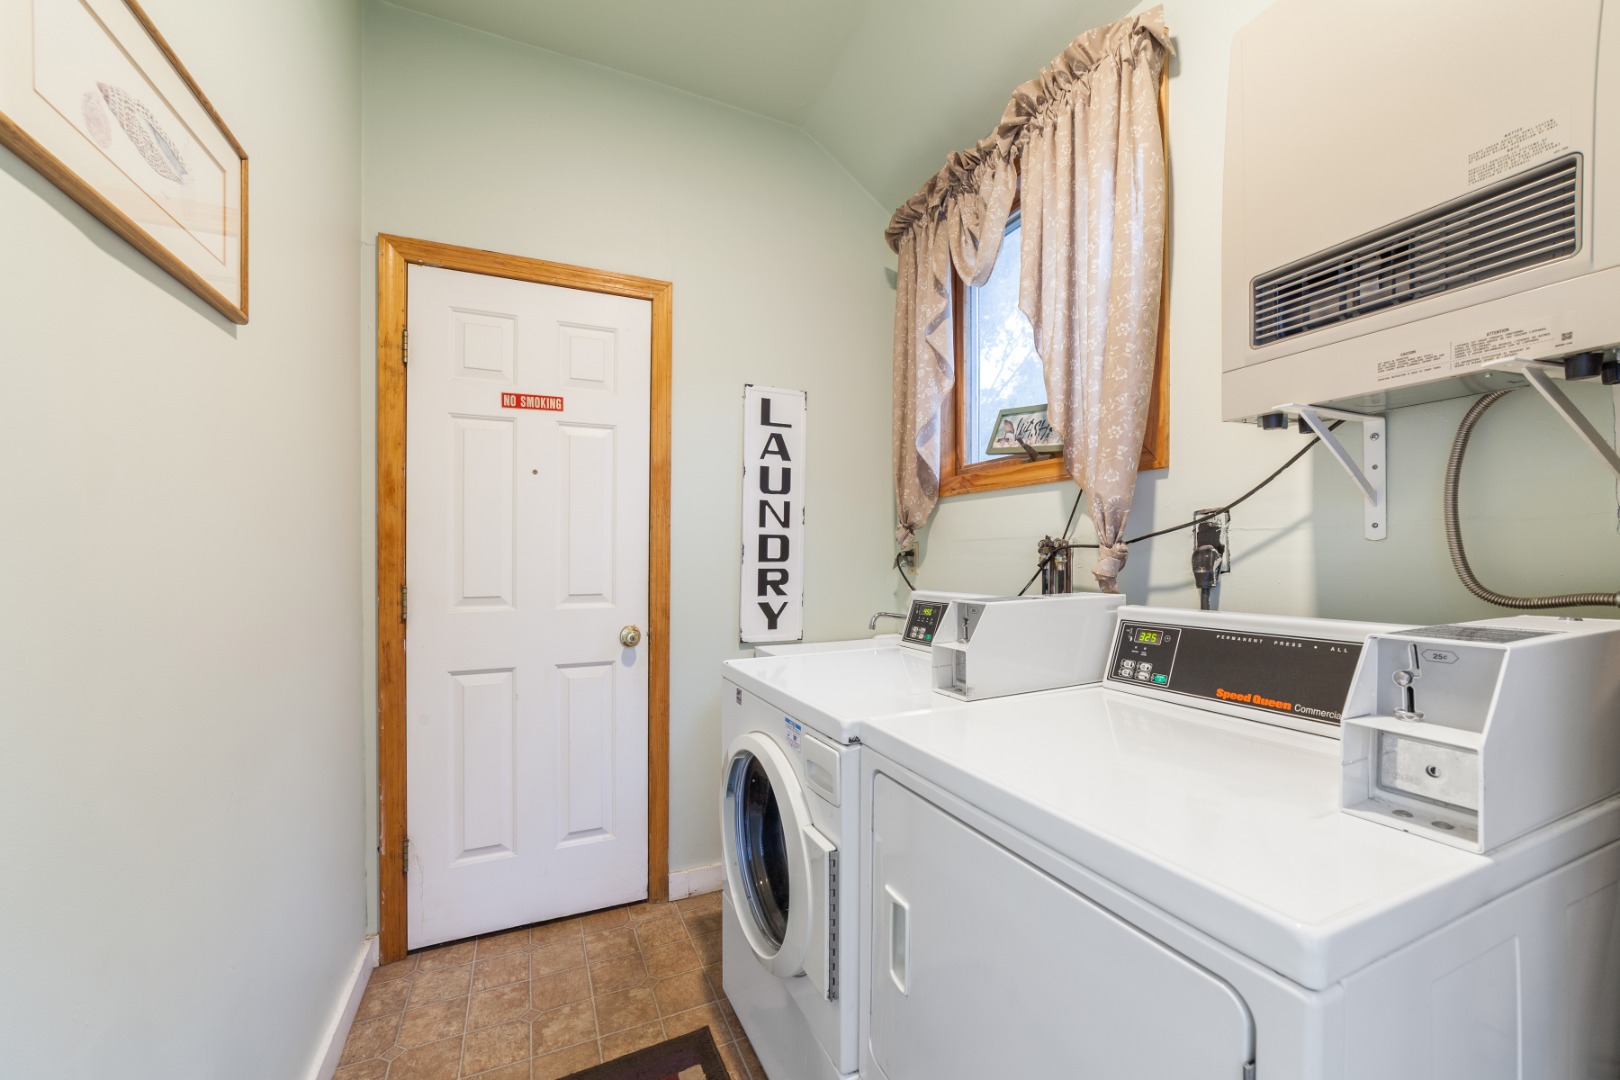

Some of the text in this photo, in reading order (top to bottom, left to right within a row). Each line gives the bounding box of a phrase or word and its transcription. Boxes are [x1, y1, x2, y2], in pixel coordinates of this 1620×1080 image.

[503, 394, 562, 410] NO SMOKING
[757, 397, 792, 630] LAUNDRY
[1139, 631, 1157, 643] 325
[1216, 634, 1264, 644] PERMANENT
[1273, 640, 1303, 648] PRESS
[1215, 687, 1341, 721] Speed Queen Commercia
